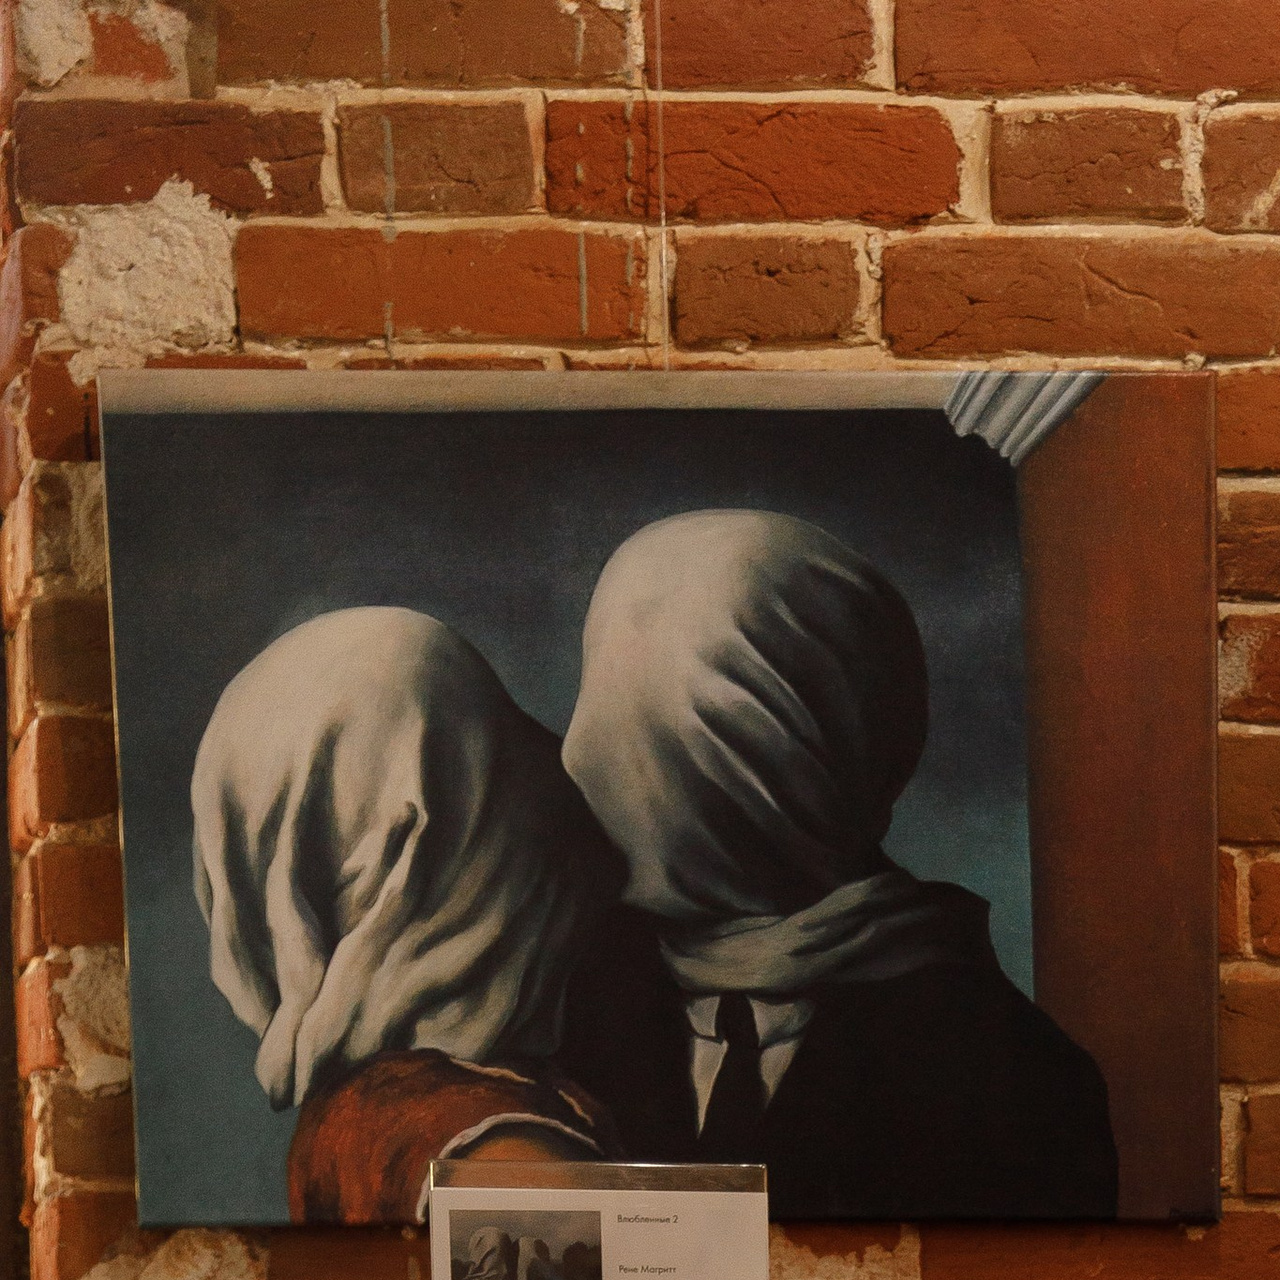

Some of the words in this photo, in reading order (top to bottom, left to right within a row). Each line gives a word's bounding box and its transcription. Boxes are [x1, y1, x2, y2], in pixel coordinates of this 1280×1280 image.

[617, 1214, 670, 1223] Влюбленные
[672, 1214, 679, 1223] 2
[618, 1264, 638, 1273] Рене
[640, 1265, 677, 1276] Магритт
